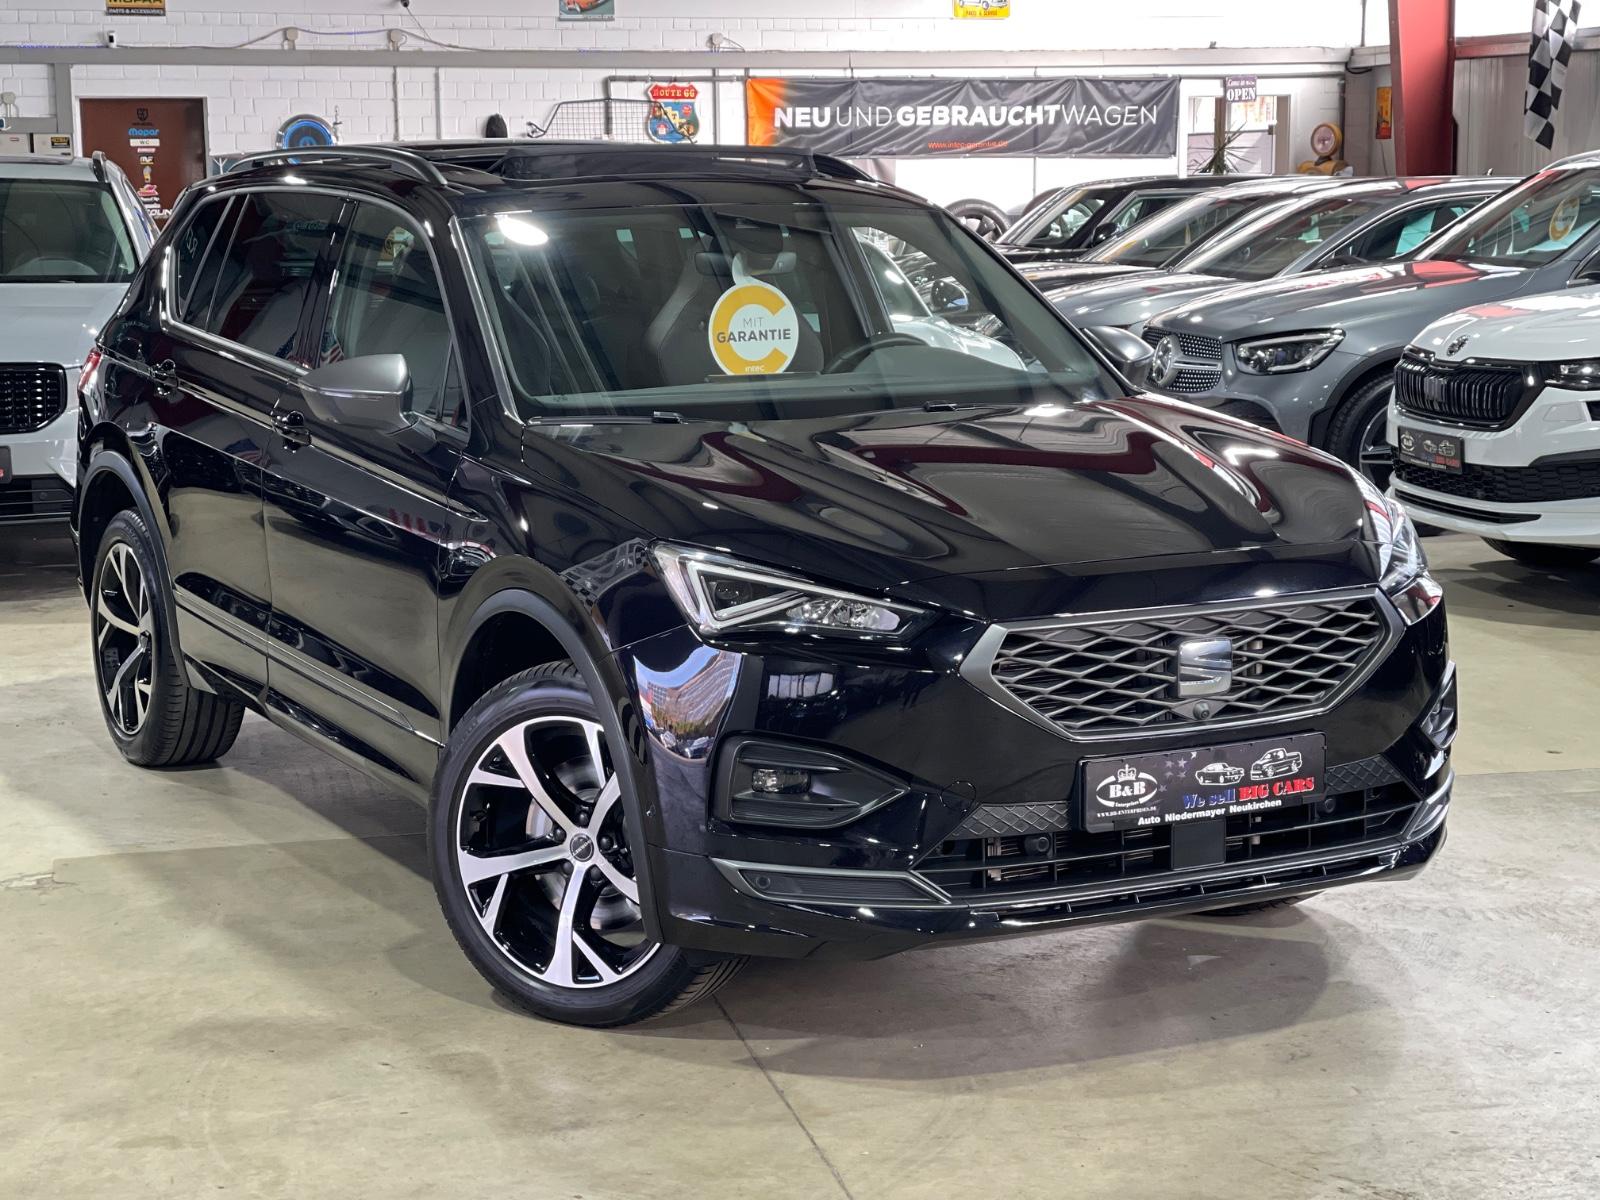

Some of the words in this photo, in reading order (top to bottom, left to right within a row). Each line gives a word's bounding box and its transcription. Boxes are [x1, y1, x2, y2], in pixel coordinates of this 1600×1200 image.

[652, 88, 682, 97] ROUTE
[683, 88, 695, 98] 66
[1226, 87, 1256, 101] OPEN
[774, 106, 831, 128] NEU
[836, 106, 892, 127] UND
[743, 317, 764, 328] MIT
[716, 328, 791, 343] GARANTIE
[1109, 781, 1146, 798] B&B
[1183, 794, 1205, 809] We
[1208, 788, 1236, 806] sell
[1238, 784, 1269, 801] BIG
[1272, 777, 1314, 796] CARS
[1138, 816, 1161, 825] Auto
[1164, 807, 1226, 822] Niedermayer
[1229, 800, 1282, 813] Neukirchen
